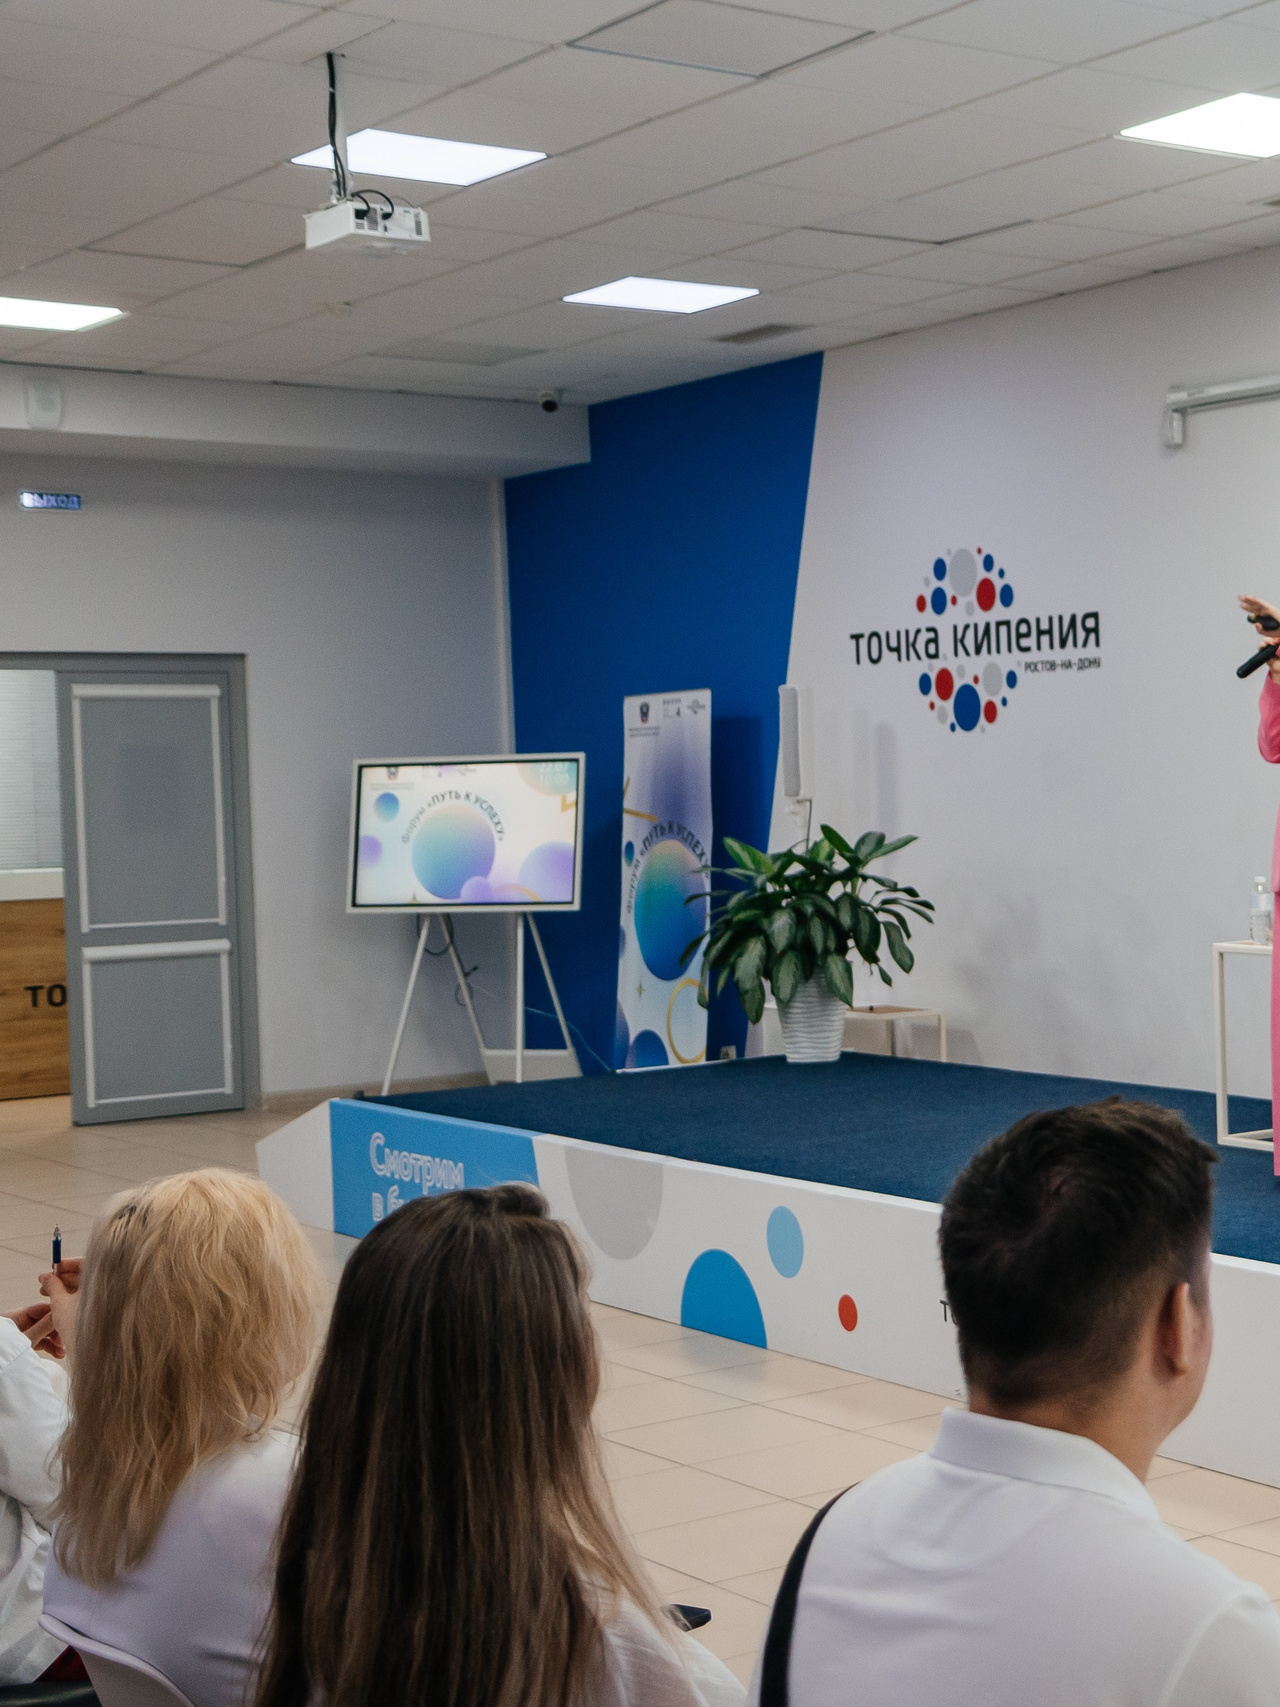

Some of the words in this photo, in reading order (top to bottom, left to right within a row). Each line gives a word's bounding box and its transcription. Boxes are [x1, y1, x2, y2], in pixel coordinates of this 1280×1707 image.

[850, 626, 940, 665] точка
[953, 611, 1100, 657] кипения
[1024, 657, 1101, 674] РОСТОВ-НА-ДОНУ
[369, 1132, 465, 1195] Смотрим
